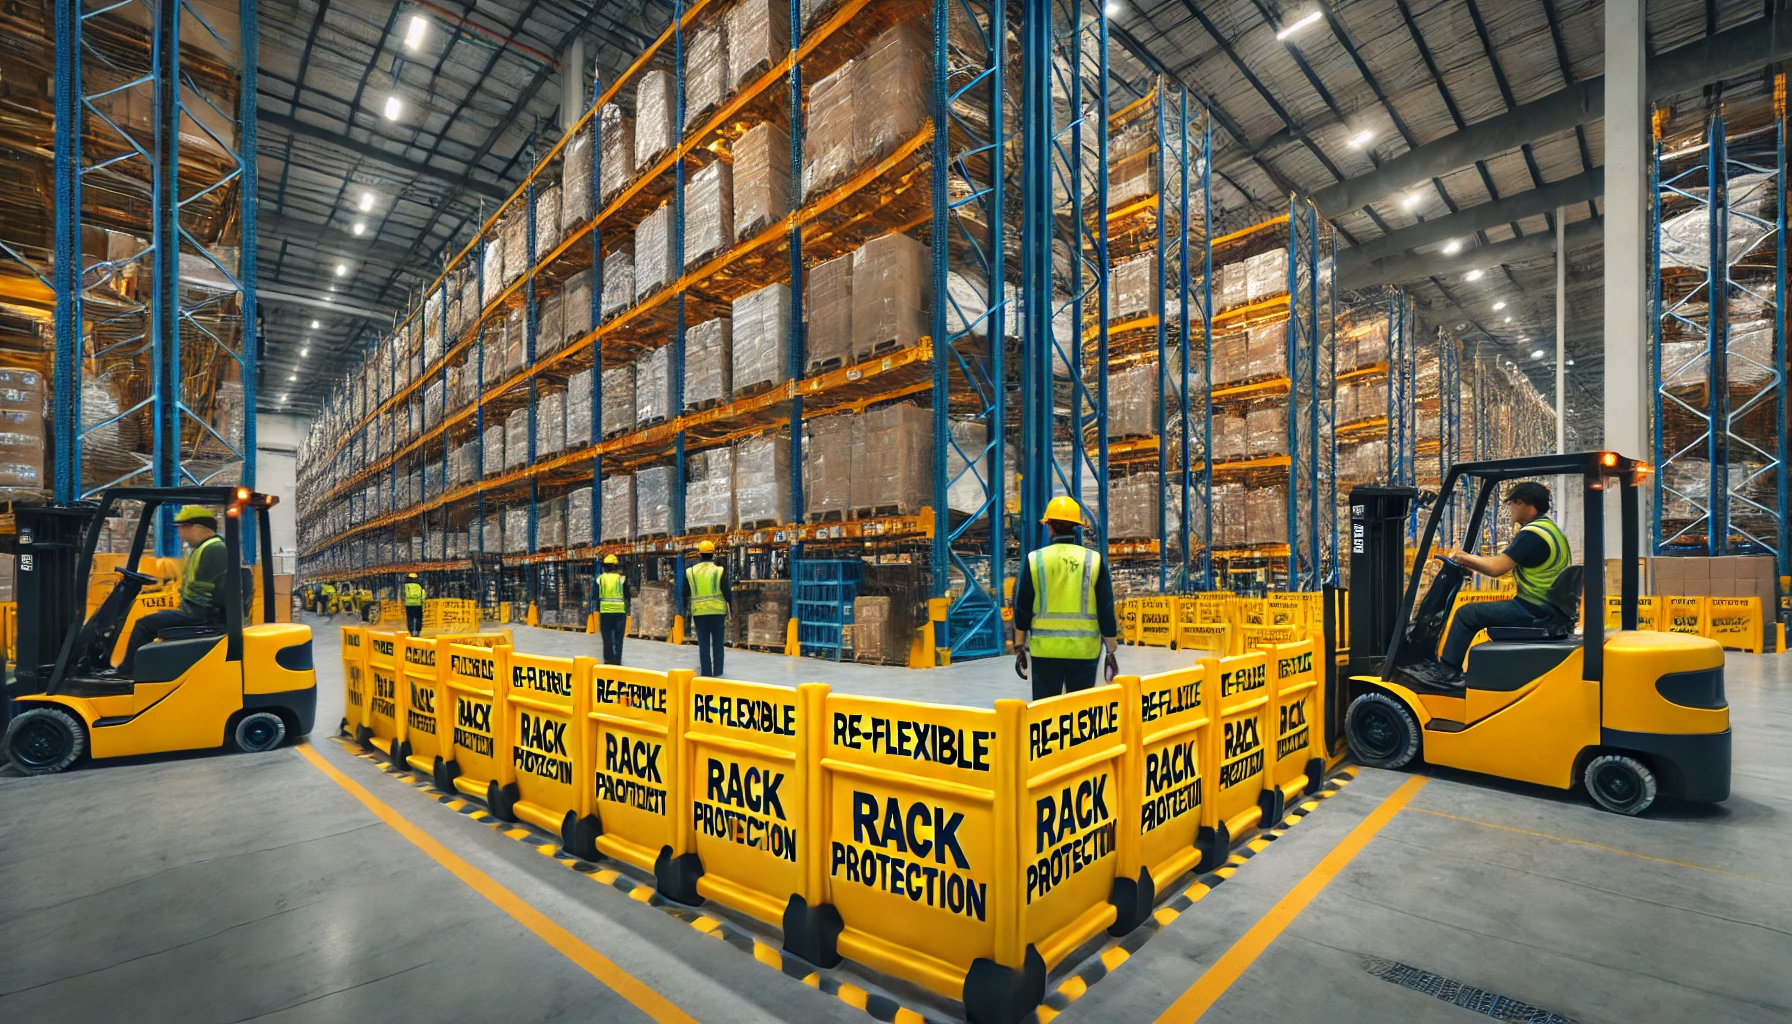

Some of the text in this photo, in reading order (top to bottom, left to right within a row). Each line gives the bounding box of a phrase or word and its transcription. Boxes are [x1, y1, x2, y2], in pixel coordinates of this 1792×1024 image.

[606, 732, 663, 784] RACK
[707, 757, 787, 821] RACK
[1146, 740, 1196, 797] RACK
[852, 790, 971, 870] RACK
[1036, 773, 1109, 855] RACK
[831, 841, 987, 922] PROTECTION
